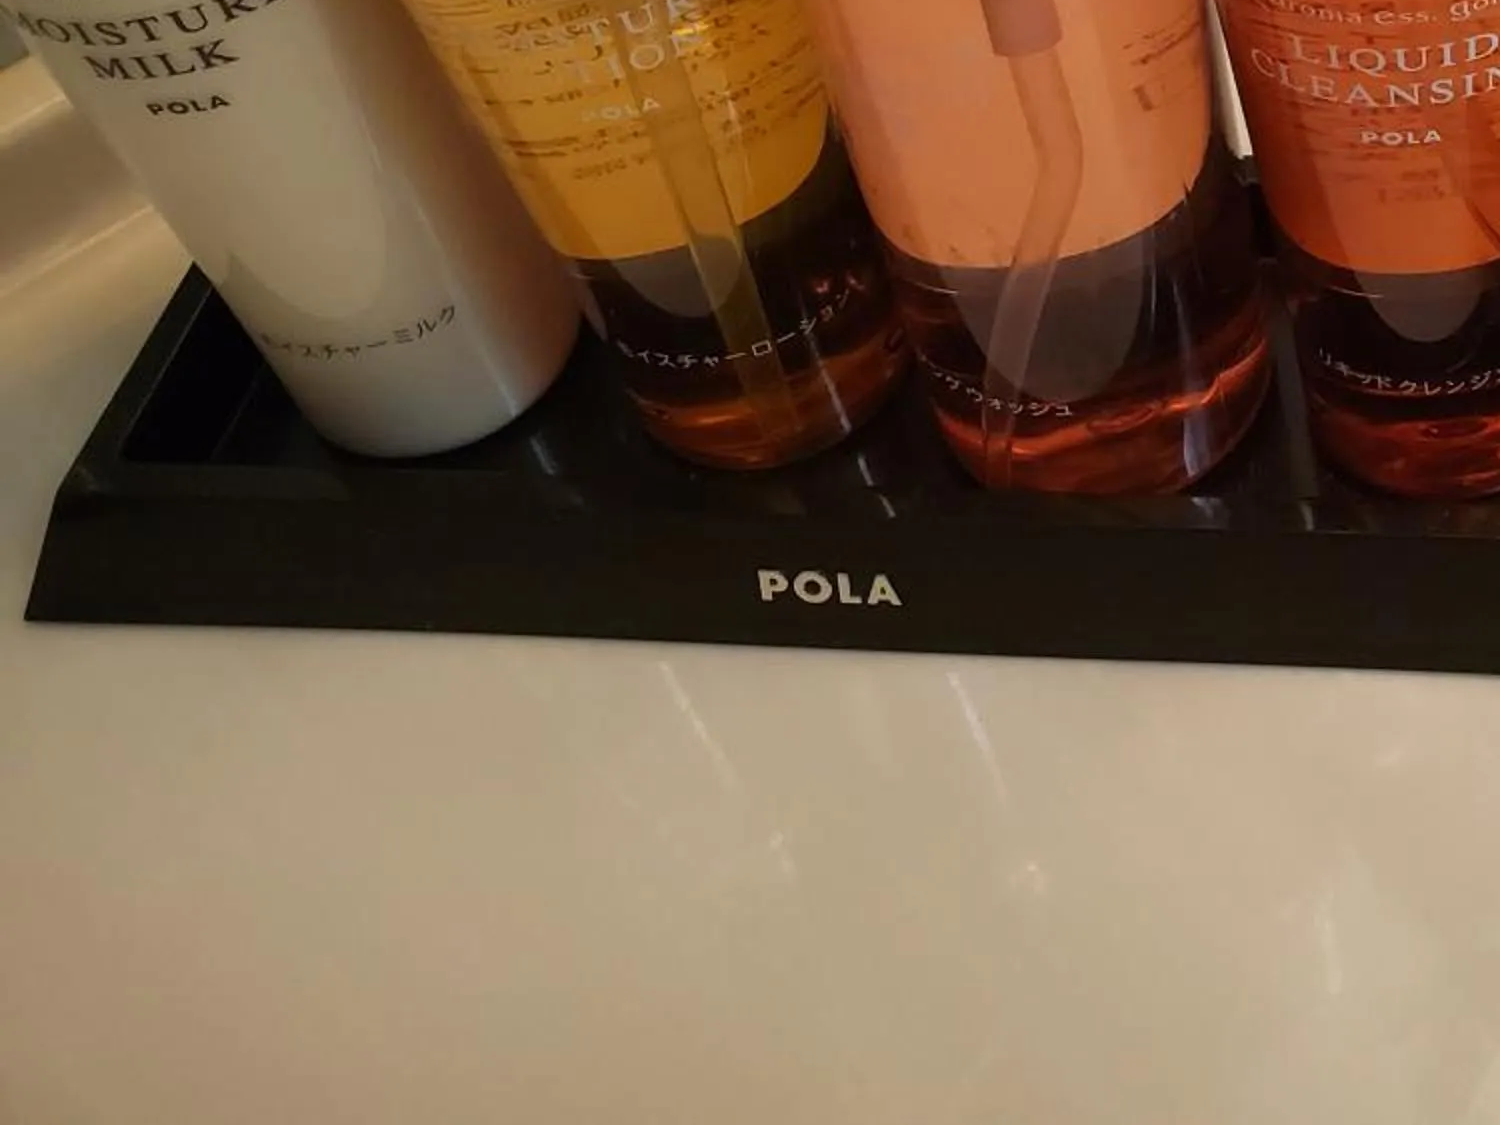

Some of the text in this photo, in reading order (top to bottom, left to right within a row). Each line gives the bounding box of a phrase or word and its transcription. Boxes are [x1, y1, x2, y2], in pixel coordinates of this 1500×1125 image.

[1373, 10, 1438, 26] ess.
[83, 37, 241, 81] MILK
[1284, 31, 1500, 78] LIQUID
[145, 94, 231, 117] POLA
[1360, 129, 1442, 146] POLA
[756, 569, 904, 606] POLA
